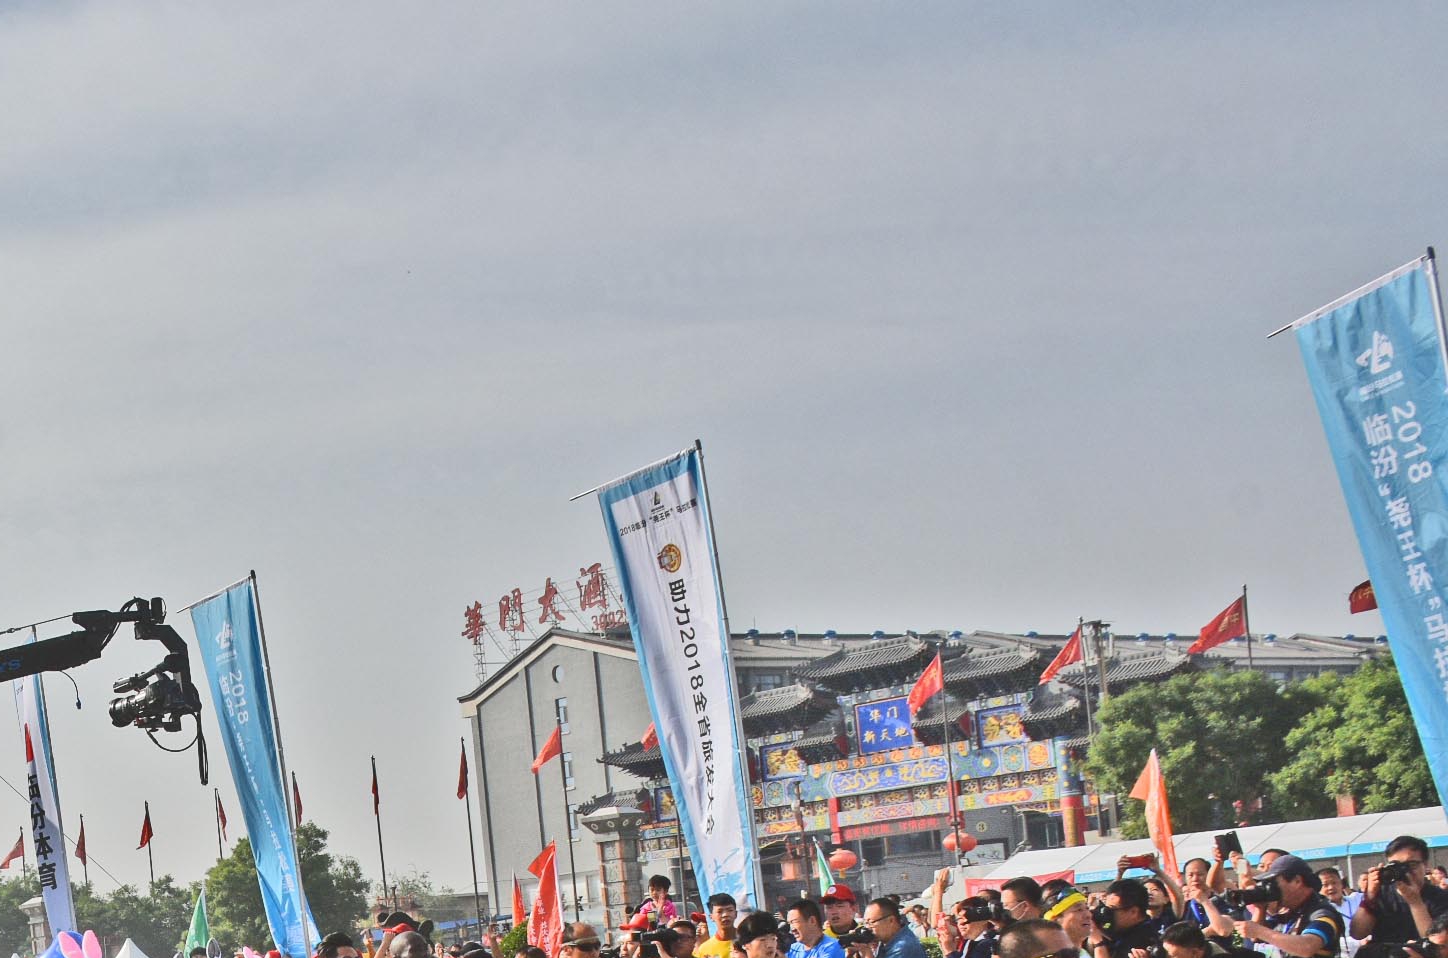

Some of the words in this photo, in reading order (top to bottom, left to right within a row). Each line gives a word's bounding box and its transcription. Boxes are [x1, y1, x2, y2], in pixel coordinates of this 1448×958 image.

[1392, 401, 1432, 484] 2018
[228, 669, 250, 726] 2018
[668, 578, 715, 836] 助力2018全省旅发大会
